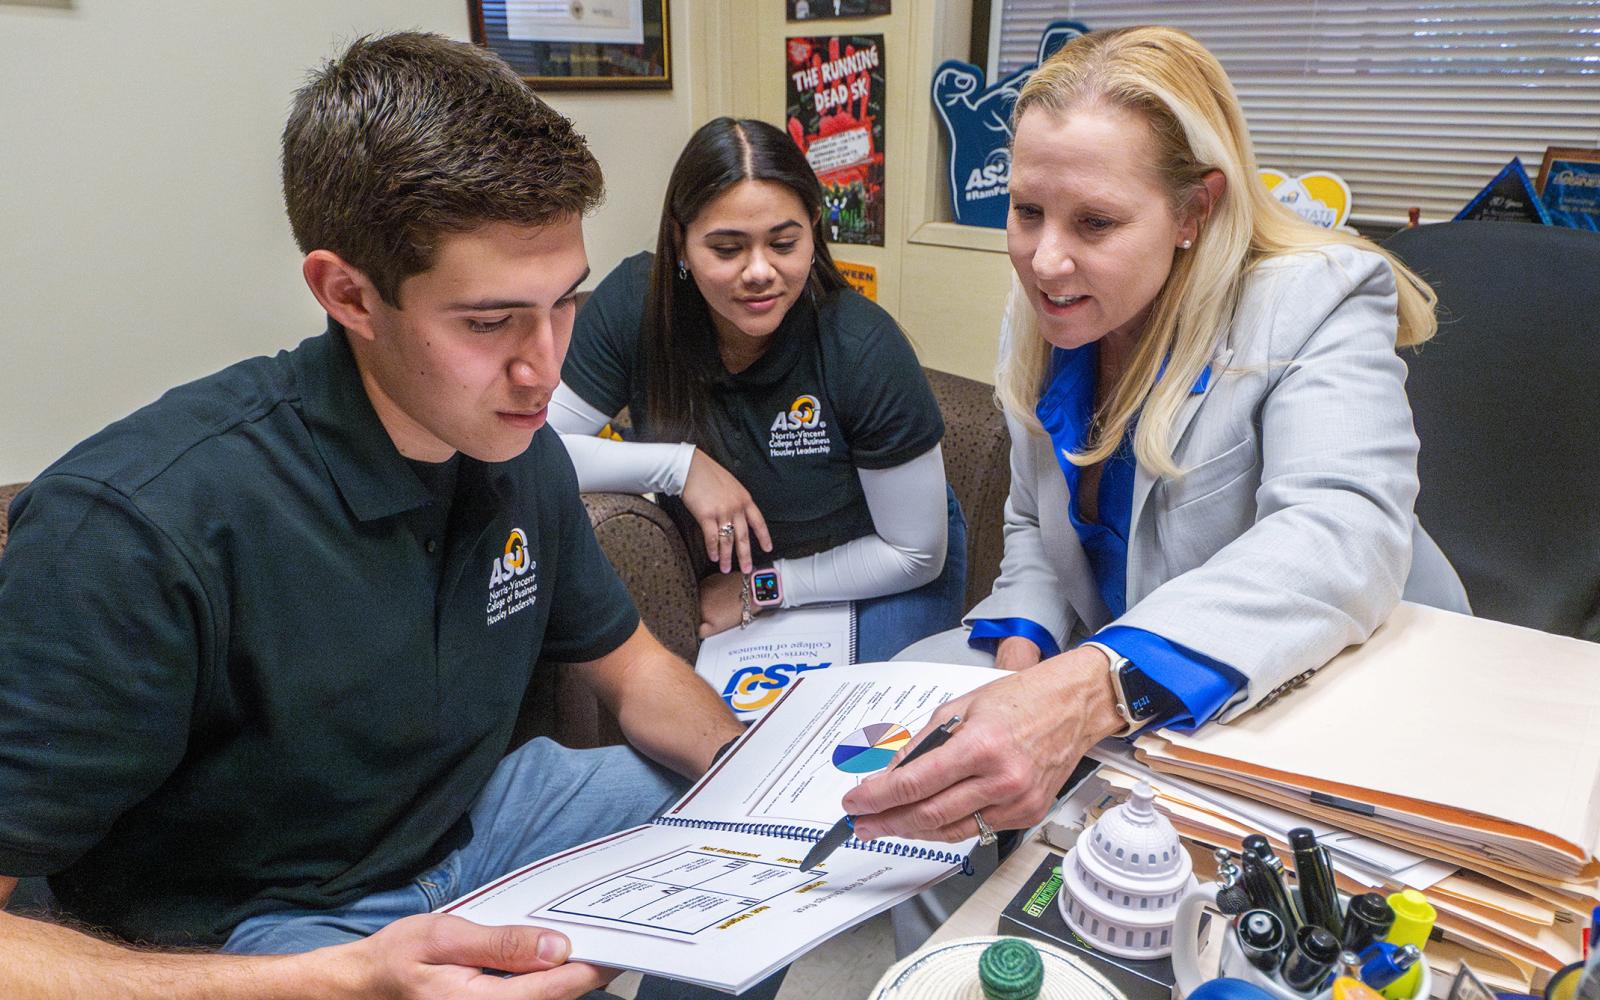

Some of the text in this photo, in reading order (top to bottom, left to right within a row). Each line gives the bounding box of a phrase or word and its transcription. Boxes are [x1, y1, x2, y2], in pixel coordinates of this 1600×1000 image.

[792, 67, 818, 92] THE
[821, 45, 879, 84] RUNNING
[814, 77, 869, 112] DEAD 5K
[965, 185, 1009, 201] #RamFa
[770, 395, 821, 431] ASU
[768, 437, 830, 450] College of Business
[771, 430, 826, 440] Norris-Vincent
[770, 445, 831, 457] Housley Leadership
[488, 527, 531, 590] ASU
[486, 583, 538, 614] College of Business
[489, 573, 536, 602] Norris-Vincent
[486, 595, 537, 627] Housley Leadership
[728, 641, 832, 656] College of Business
[739, 650, 818, 662] Norris-Vincent
